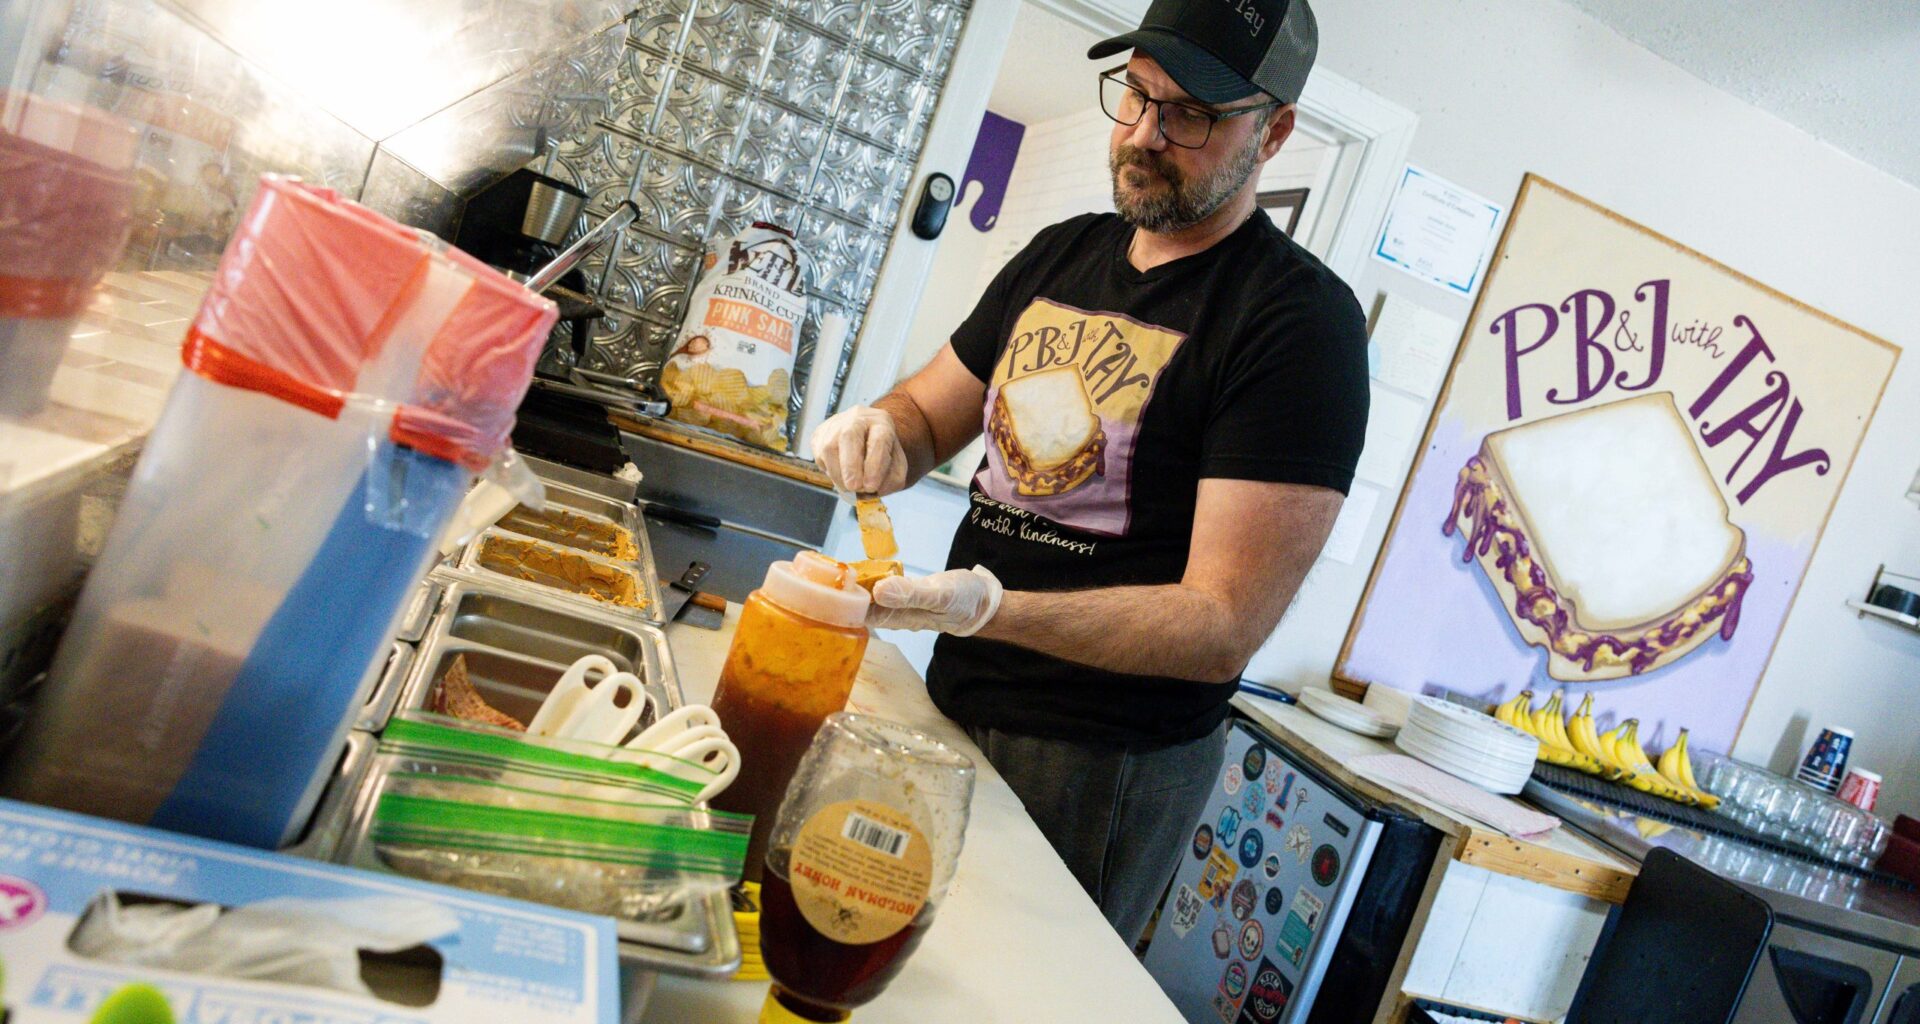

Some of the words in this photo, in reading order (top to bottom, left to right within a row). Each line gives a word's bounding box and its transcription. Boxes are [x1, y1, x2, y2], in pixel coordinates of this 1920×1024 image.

[713, 283, 775, 312] KRINKLE
[776, 304, 804, 326] CUT
[744, 276, 780, 301] BRAND
[711, 301, 753, 326] PINK
[757, 313, 794, 341] SALT
[1671, 319, 1725, 359] with
[1007, 319, 1087, 379] PB&J
[1082, 320, 1150, 406] TAY
[1489, 279, 1670, 421] PB&J
[1688, 314, 1831, 506] TAY
[981, 515, 1016, 538] with
[1020, 518, 1097, 556] Kindness!
[793, 861, 842, 891] HONEY
[844, 885, 917, 917] HOLDMAN
